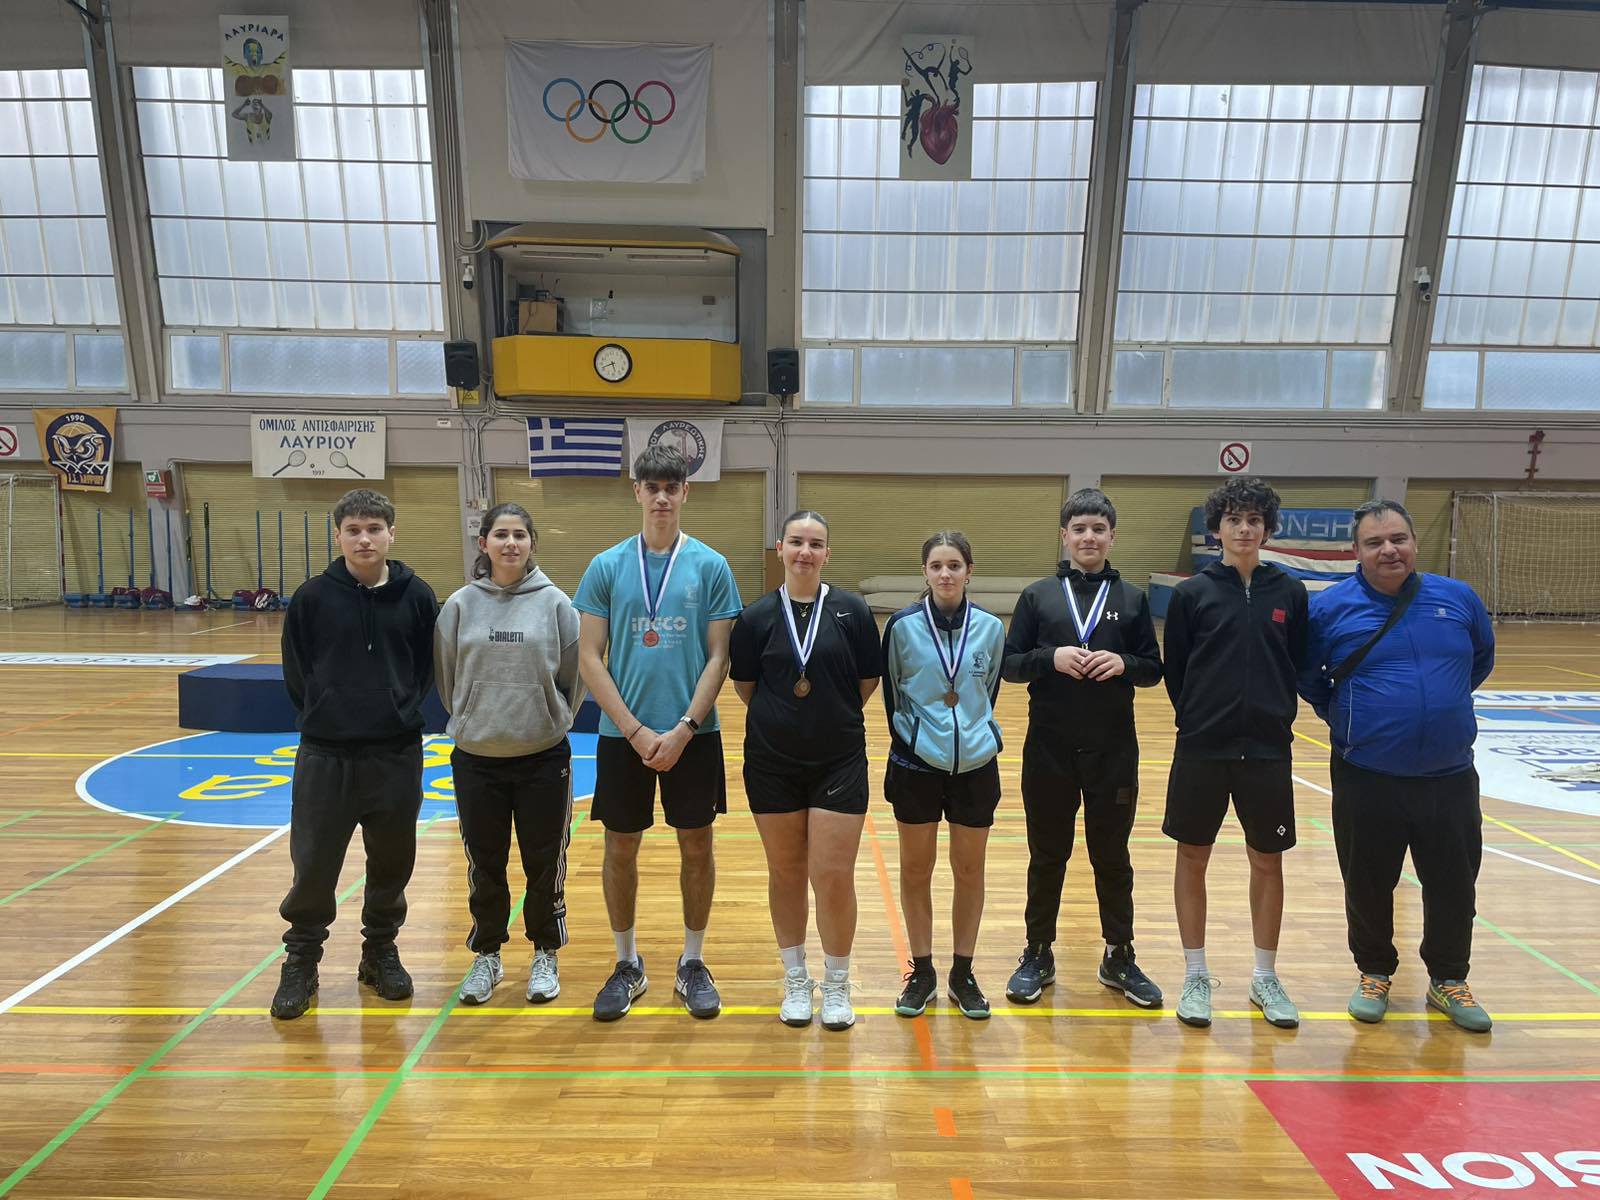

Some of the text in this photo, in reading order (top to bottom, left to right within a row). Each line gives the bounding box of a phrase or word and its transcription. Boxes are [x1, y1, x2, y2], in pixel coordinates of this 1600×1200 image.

[65, 414, 85, 422] 1990
[259, 418, 377, 433] ΟΜΙΛΟΣ ΑΝΤΙΣΦΑΙΡΙΣΗΣ
[280, 435, 356, 449] ΛΑΥΡΙΟΥ
